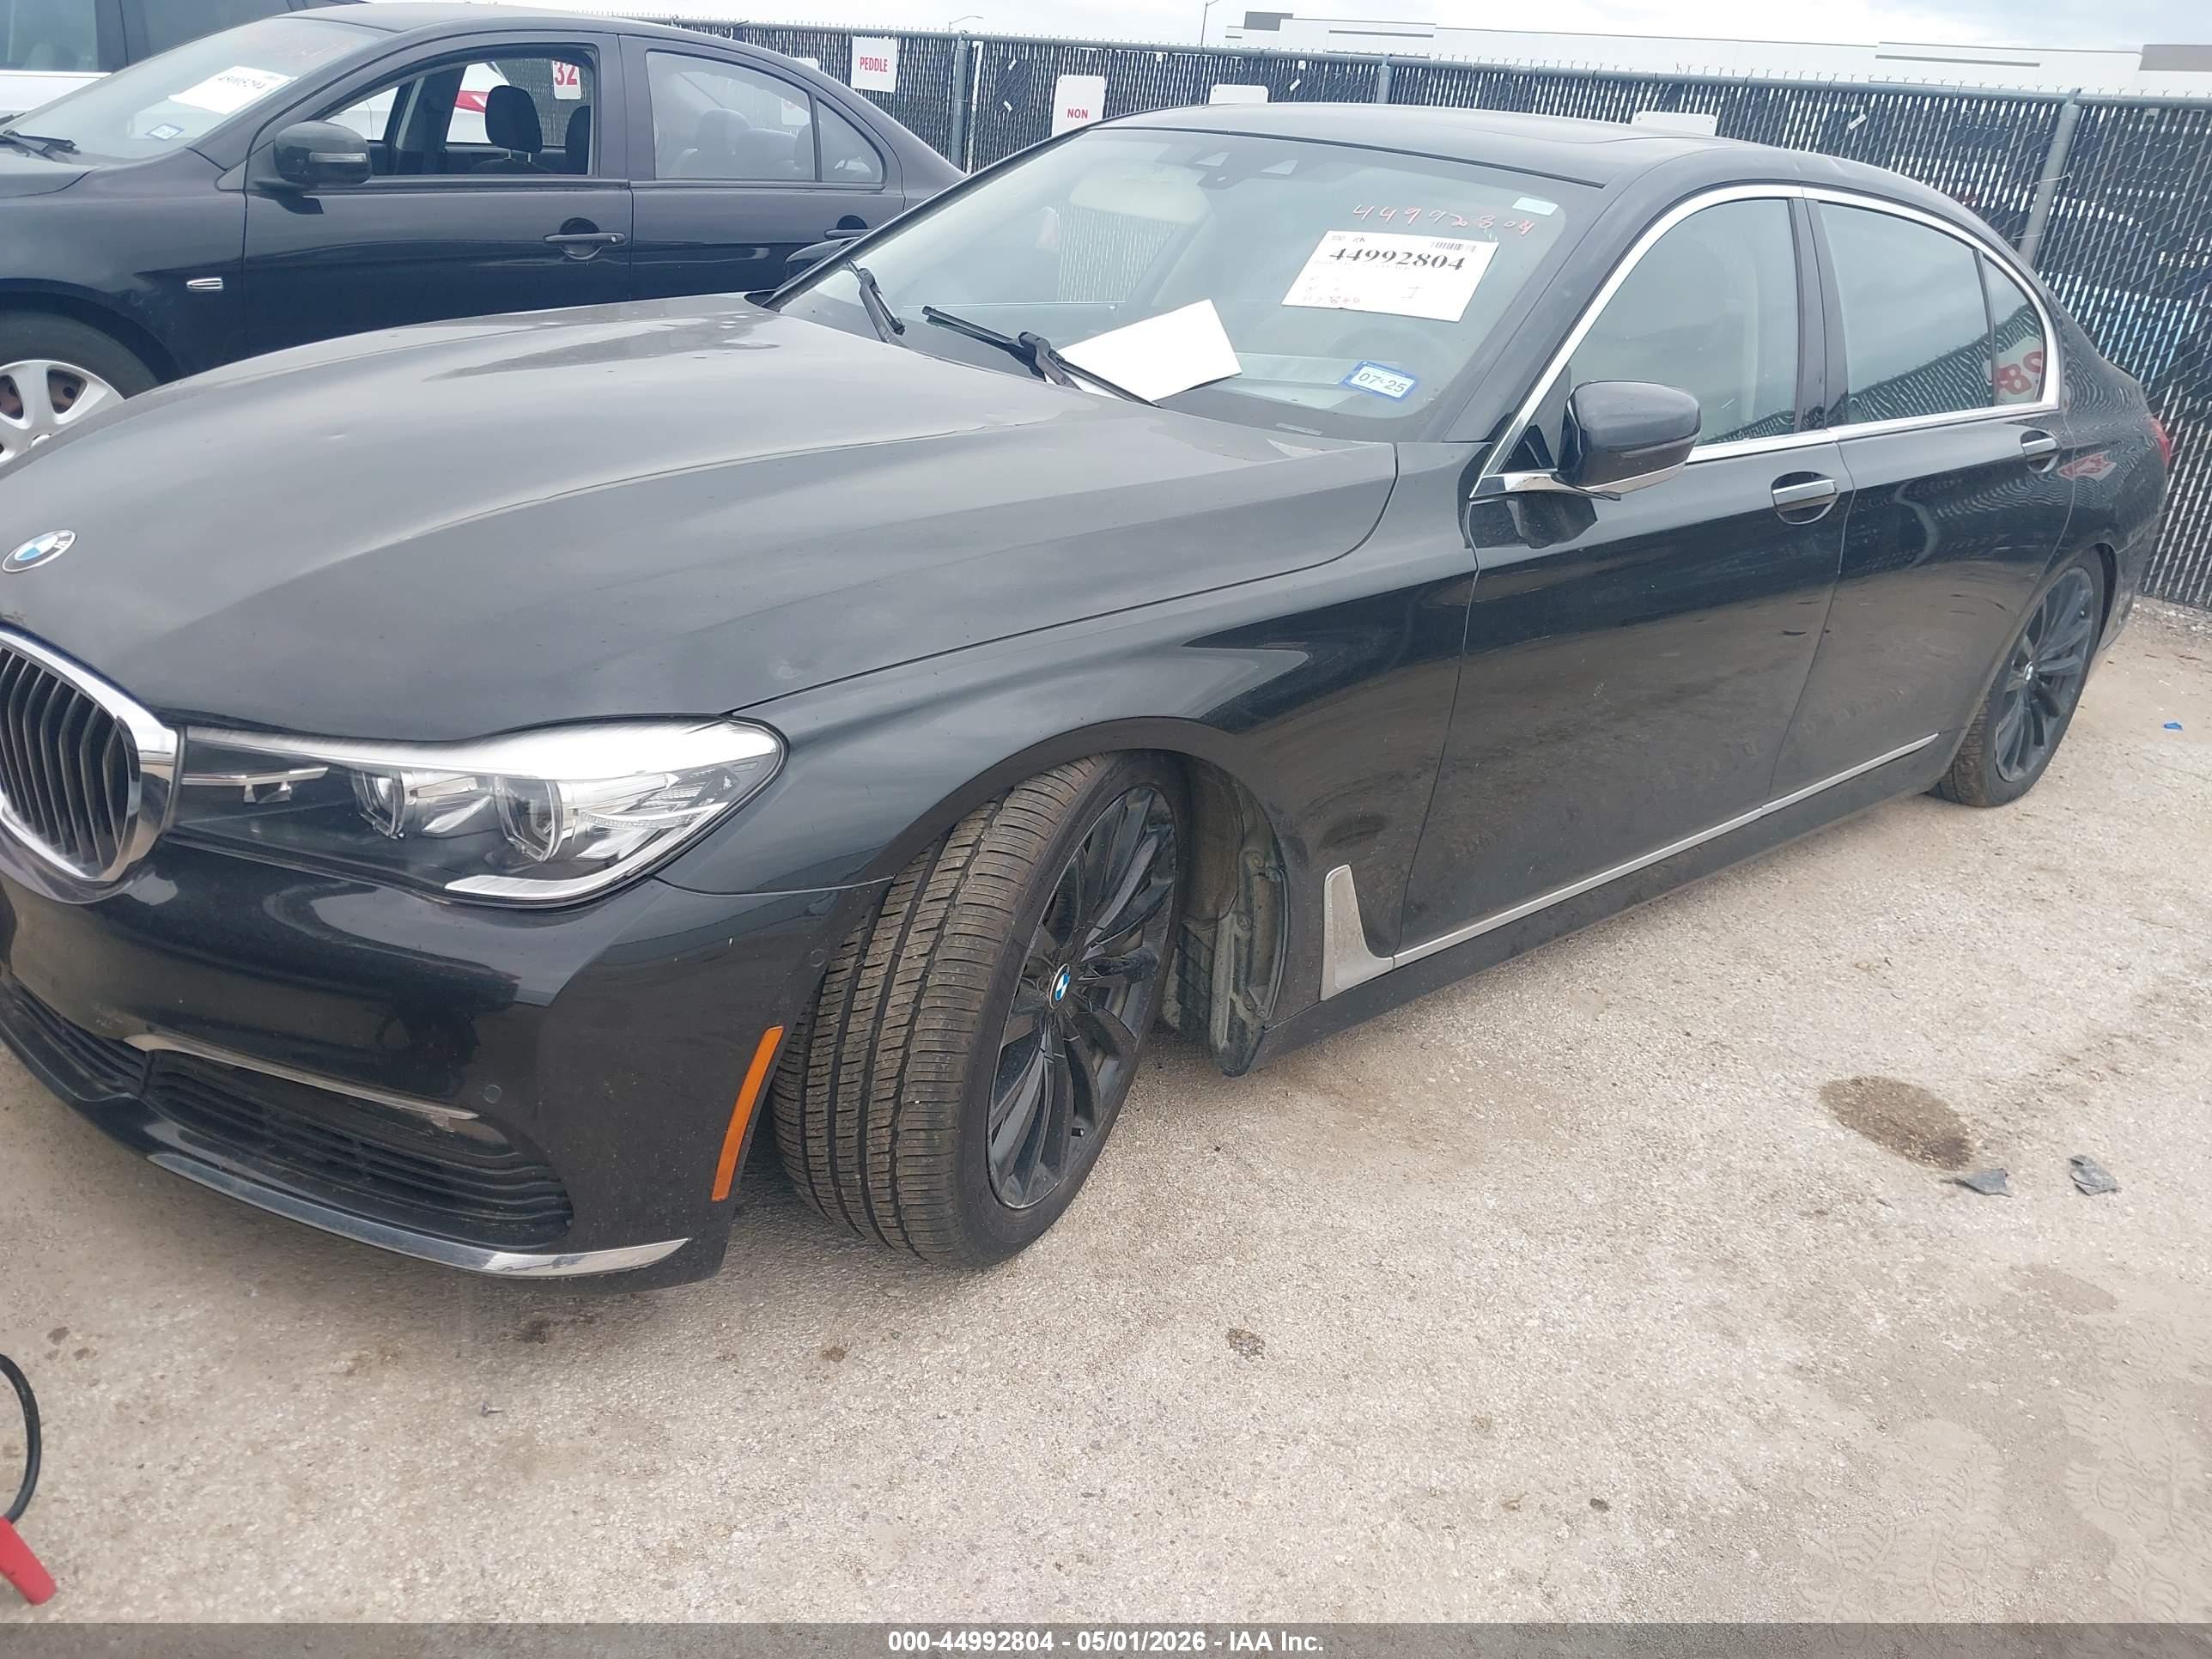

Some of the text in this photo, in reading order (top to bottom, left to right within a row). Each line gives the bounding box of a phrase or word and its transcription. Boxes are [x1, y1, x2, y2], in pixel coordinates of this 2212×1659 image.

[554, 61, 578, 86] 32
[860, 57, 889, 73] PEDDLE
[1066, 108, 1089, 119] NON
[1329, 247, 1466, 271] 44992804
